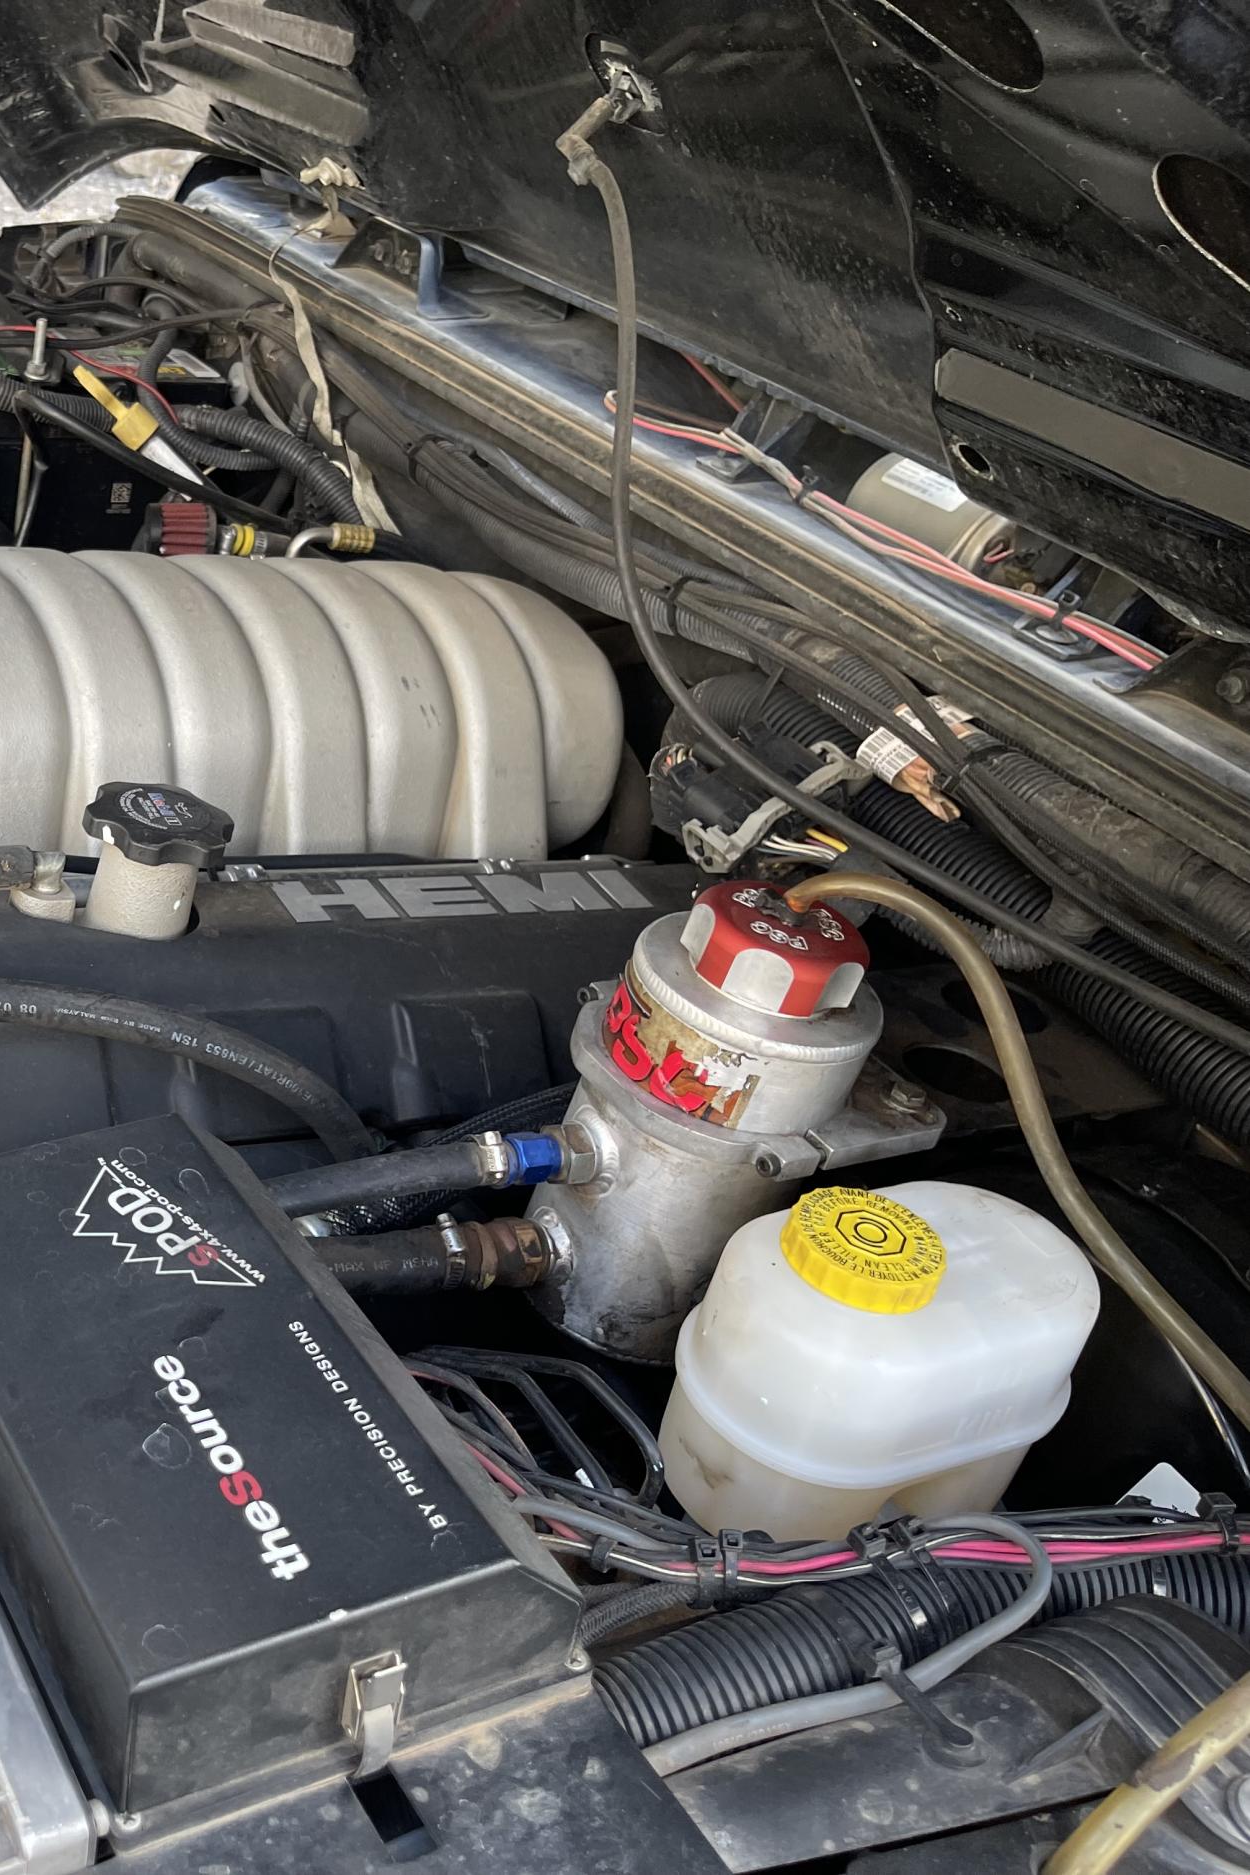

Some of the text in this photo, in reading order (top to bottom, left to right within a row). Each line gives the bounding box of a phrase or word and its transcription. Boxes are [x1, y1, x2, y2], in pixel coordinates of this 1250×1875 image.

[271, 869, 654, 924] HEMI
[20, 1003, 37, 1014] 08
[170, 1031, 198, 1048] 1SN
[839, 1188, 870, 1199] AVANT
[818, 1197, 859, 1212] BEFORE
[110, 1159, 267, 1284] www.4x4s-pod.com
[819, 1231, 858, 1262] FILLER
[401, 1256, 439, 1270] MSHA
[288, 1320, 448, 1530] BY PRECISION DESIGNS
